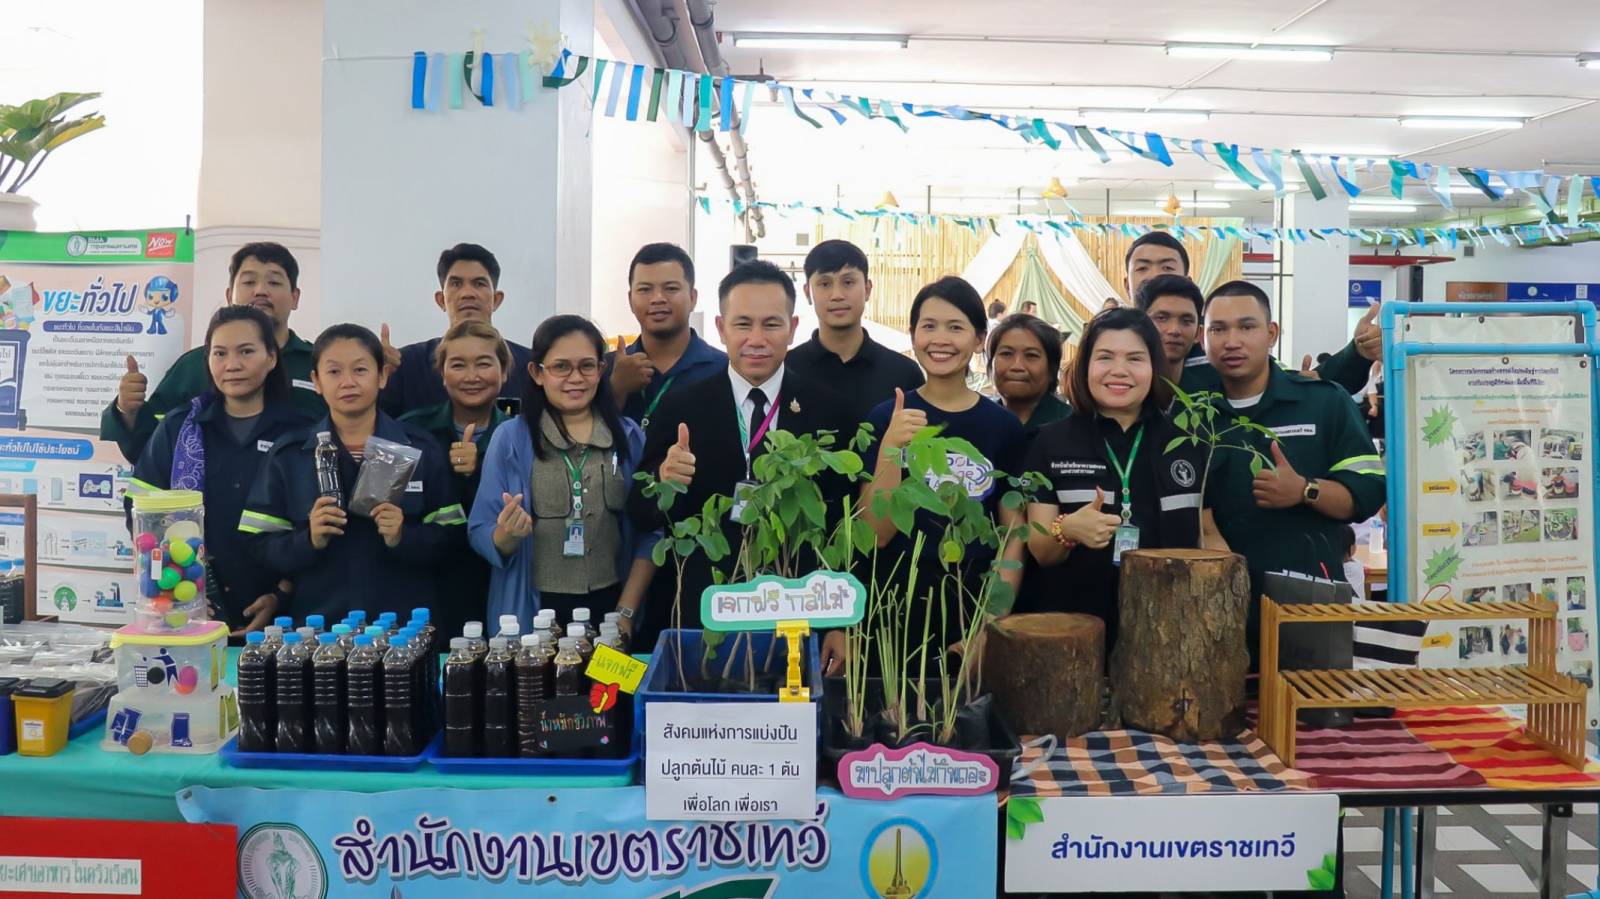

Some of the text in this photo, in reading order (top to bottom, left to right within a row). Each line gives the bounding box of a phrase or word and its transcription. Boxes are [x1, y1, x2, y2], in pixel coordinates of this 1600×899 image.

[42, 277, 138, 314] ขยะทั่วไป
[663, 723, 798, 741] สังคมแห่งการแบ่งปัน
[661, 758, 800, 781] ปลูกต้นไม้ คนละ 1 ต้น
[683, 792, 779, 812] เพื่อโลก เพื่อเรา
[1050, 832, 1296, 860] สำนักงานเขตราชเทวี
